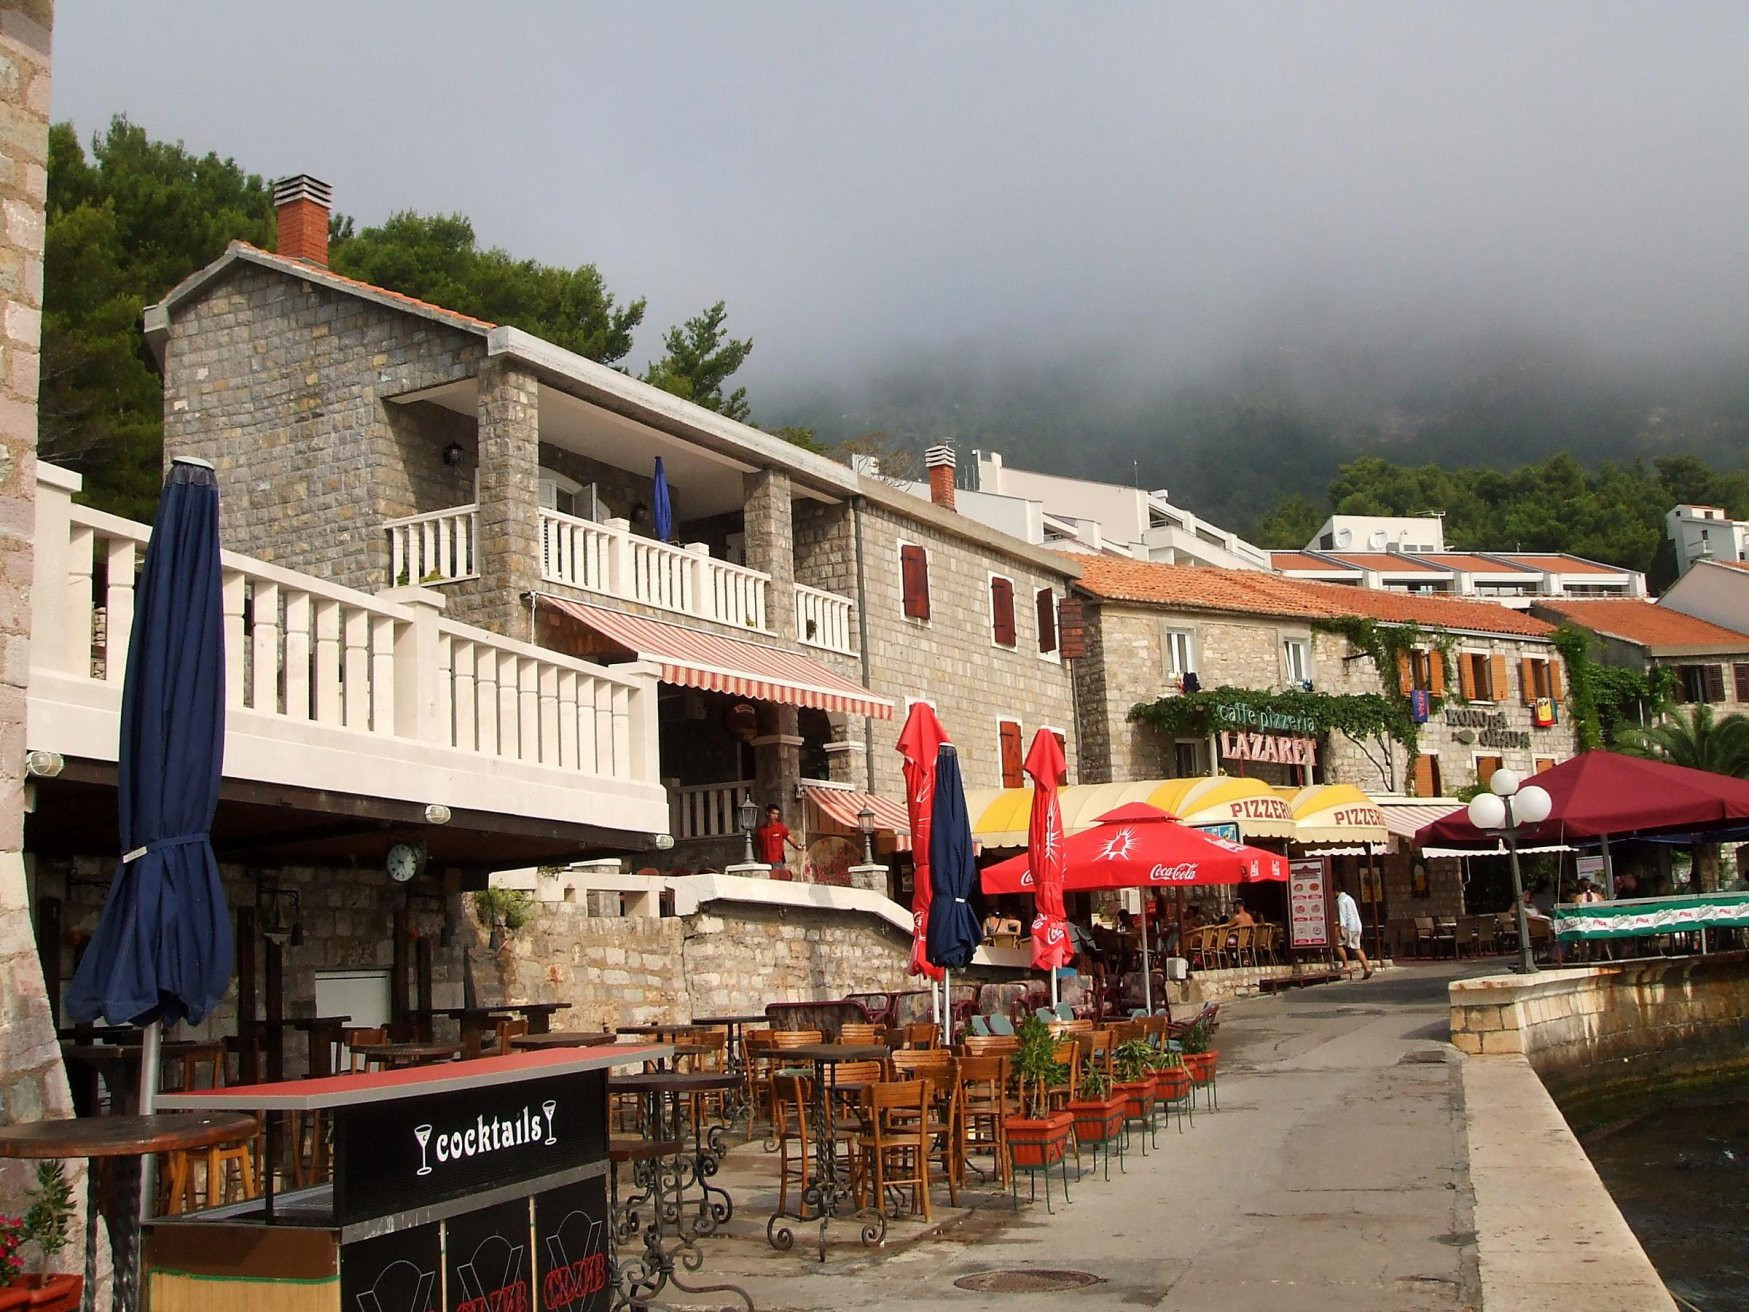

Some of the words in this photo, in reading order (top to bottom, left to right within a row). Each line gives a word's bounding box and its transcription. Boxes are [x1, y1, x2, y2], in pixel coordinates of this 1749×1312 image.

[1220, 729, 1318, 766] LAZARET
[1150, 863, 1198, 880] Coca-Cola
[436, 1106, 542, 1163] cocktails
[543, 1252, 606, 1310] CLUB
